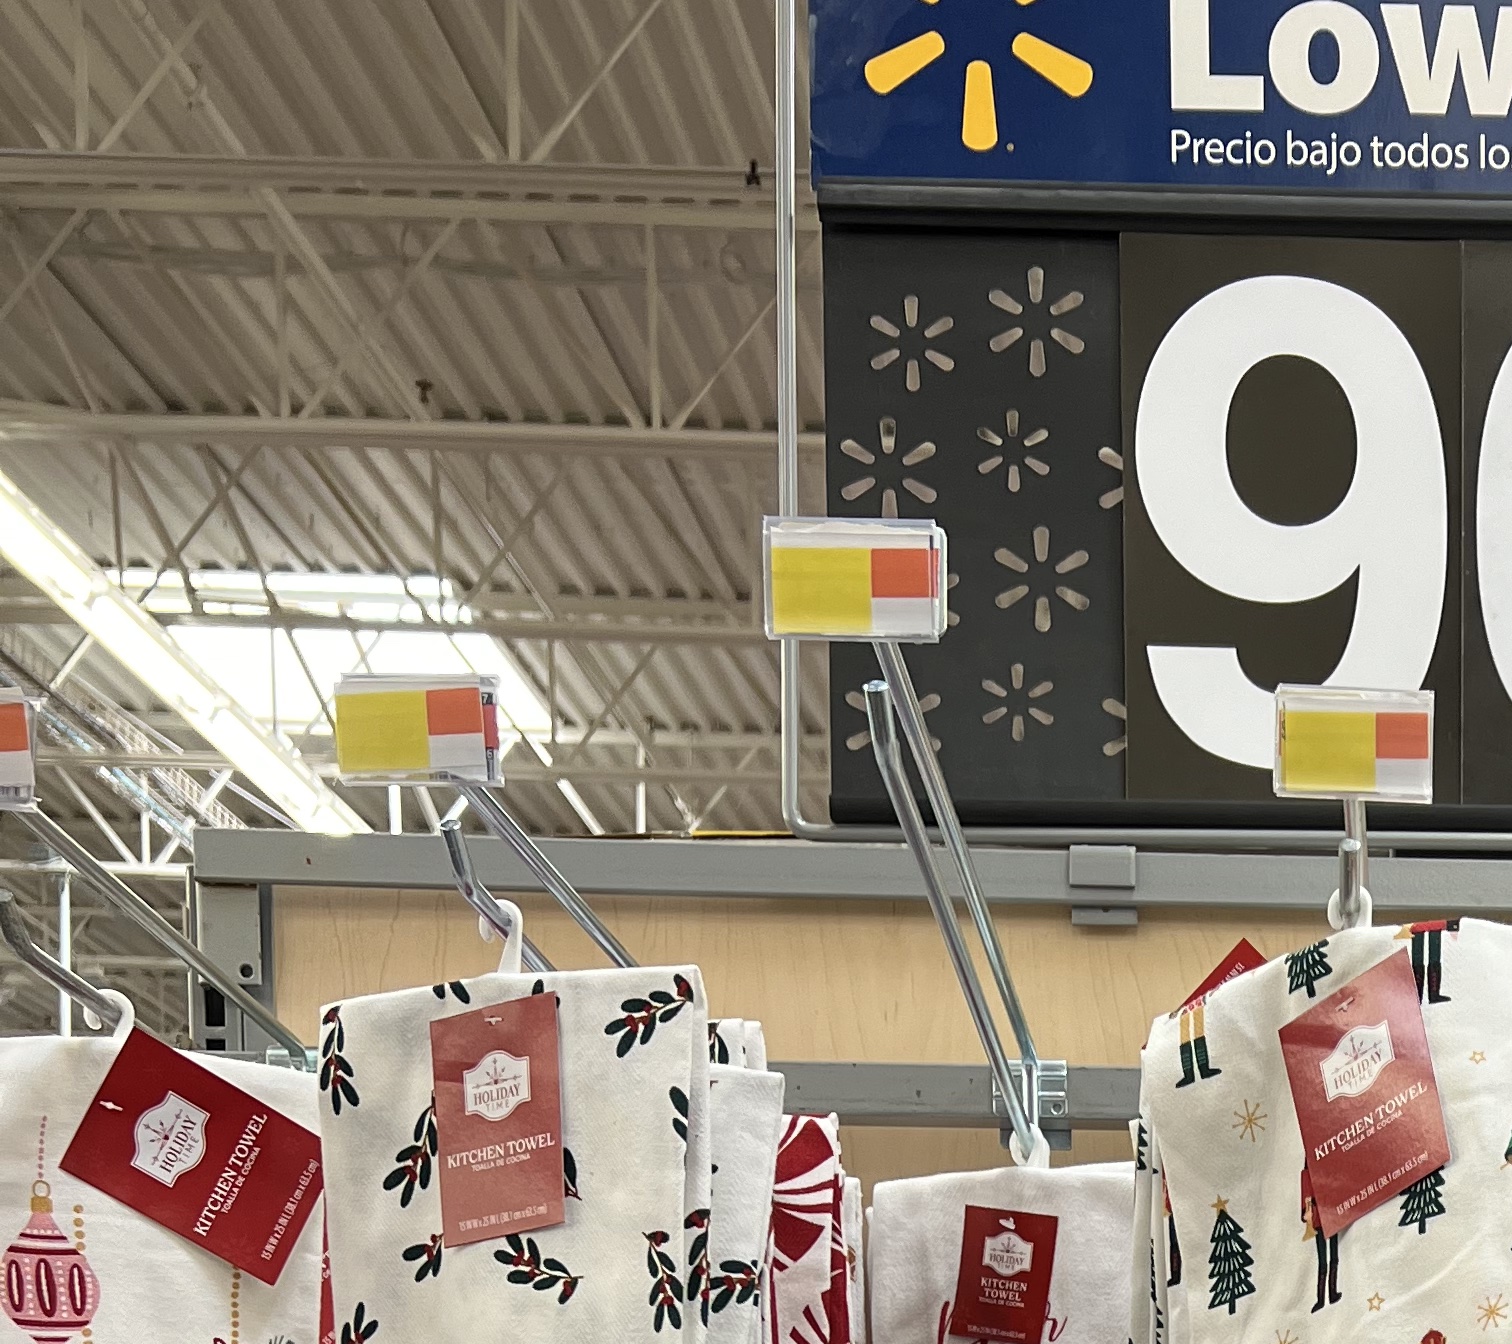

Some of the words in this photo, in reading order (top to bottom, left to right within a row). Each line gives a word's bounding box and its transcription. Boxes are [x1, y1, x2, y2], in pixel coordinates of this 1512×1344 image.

[1170, 129, 1276, 166] Precio
[1286, 130, 1362, 175] bajo
[1370, 132, 1469, 170] todos
[1334, 1051, 1383, 1090] HOLIDAY
[1348, 1070, 1373, 1088] TIME
[474, 1084, 520, 1105] HOLIDAY
[486, 1102, 509, 1110] TIME
[1315, 1113, 1376, 1161] KITCHEN
[1376, 1080, 1428, 1122] TOWEL
[159, 1114, 197, 1173] HOLIDAY
[179, 1134, 200, 1165] TIME
[447, 1144, 504, 1169] KITCHEN
[506, 1133, 555, 1156] TOWEL
[194, 1165, 237, 1236] KITCHEN
[228, 1109, 267, 1170] TOWEL
[222, 1186, 240, 1214] TOALLA
[236, 1174, 246, 1186] DE
[242, 1145, 261, 1175] COCINA
[989, 1253, 1025, 1265] HOLIDAY
[981, 1277, 1027, 1291] KITCHEN
[984, 1288, 1021, 1301] TOWEL
